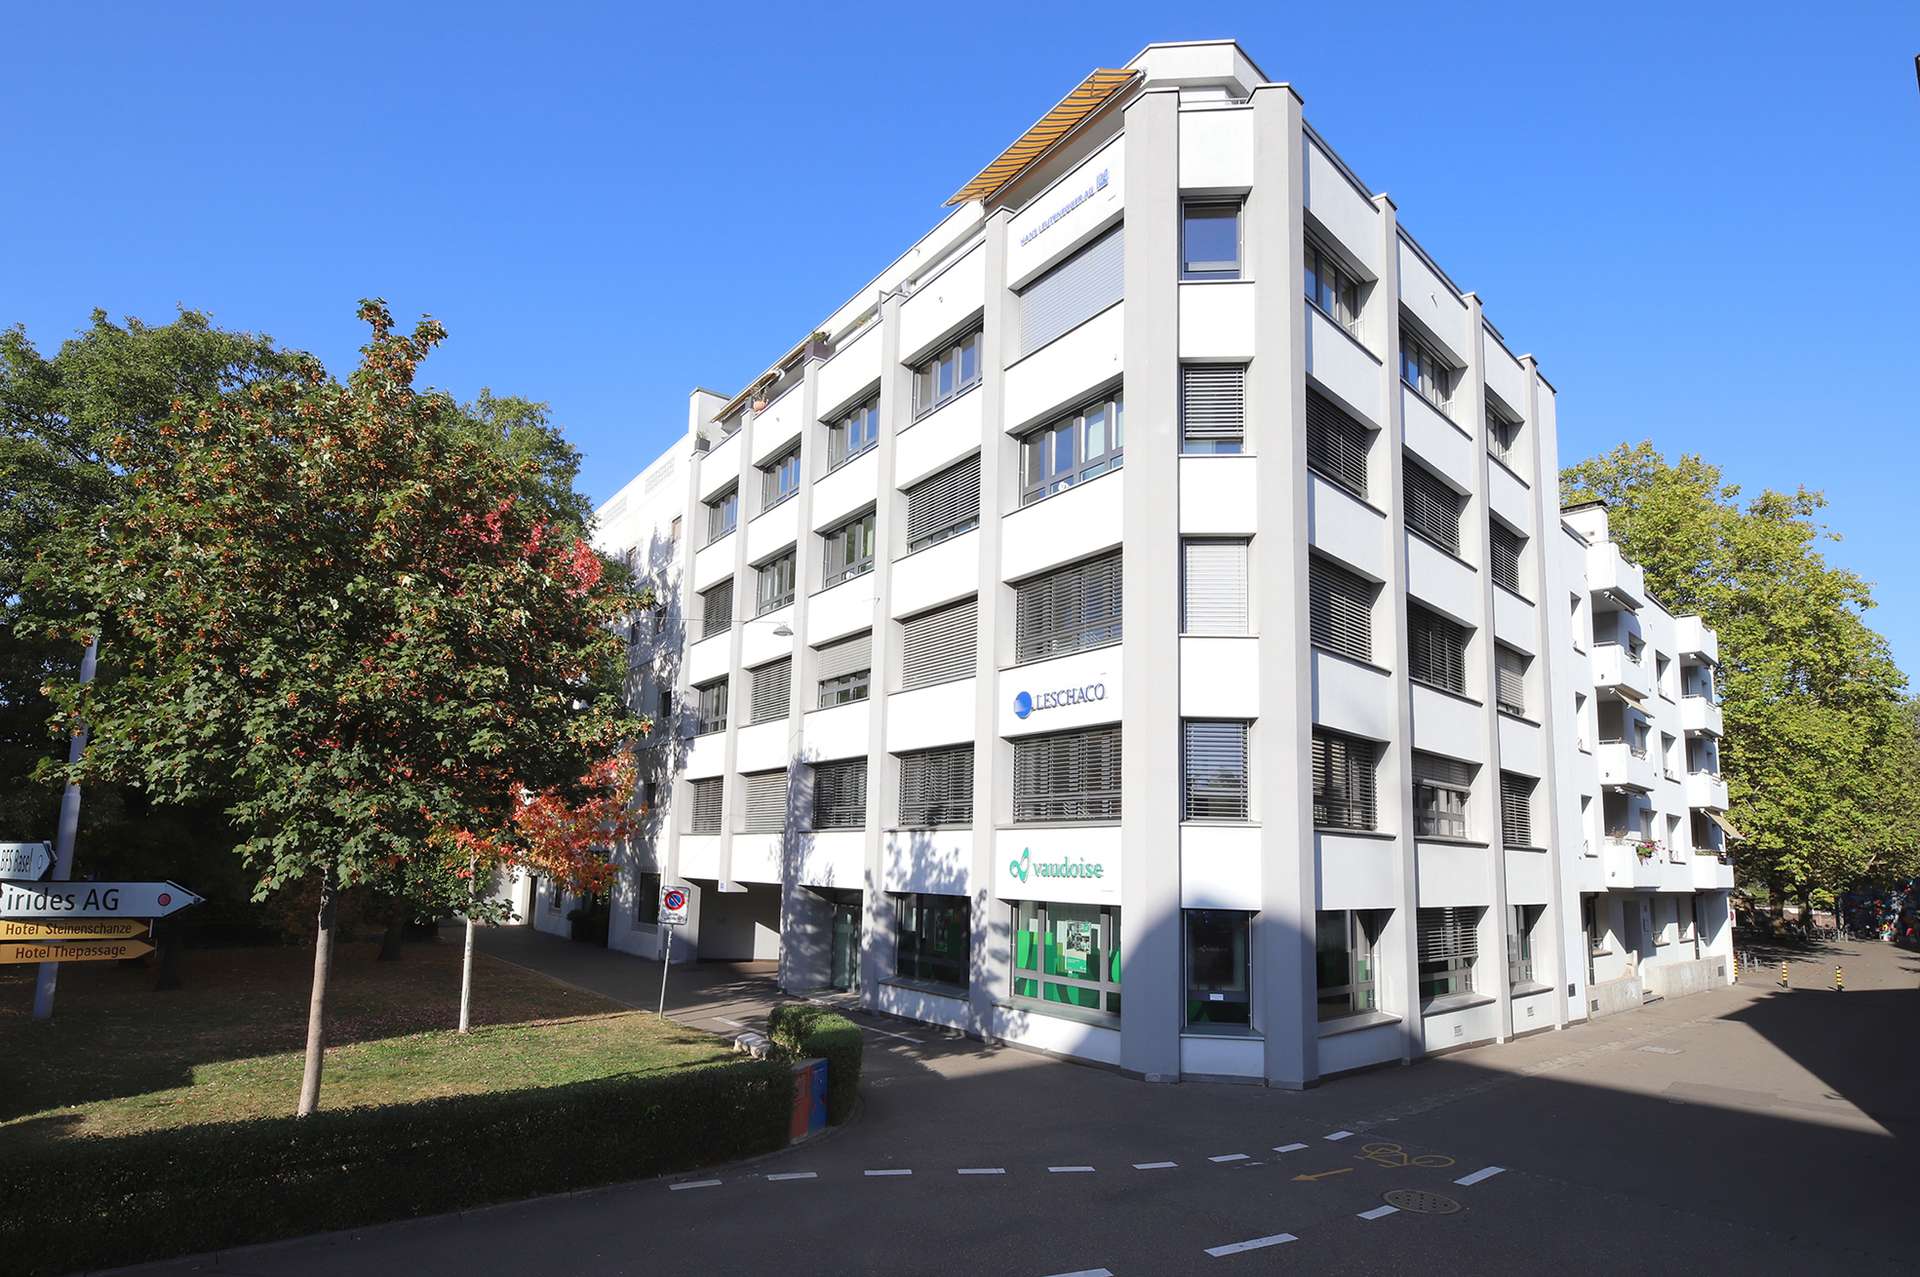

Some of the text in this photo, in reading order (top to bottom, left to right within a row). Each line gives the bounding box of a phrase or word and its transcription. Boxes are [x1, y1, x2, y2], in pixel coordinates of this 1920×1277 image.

[1036, 683, 1105, 710] LESCHACO
[13, 847, 34, 873] Basel
[1033, 856, 1104, 878] vaudoise
[7, 888, 120, 911] irides AG
[6, 923, 132, 935] Hotel Steinenschanze
[15, 944, 127, 960] Hotel Thepassage
